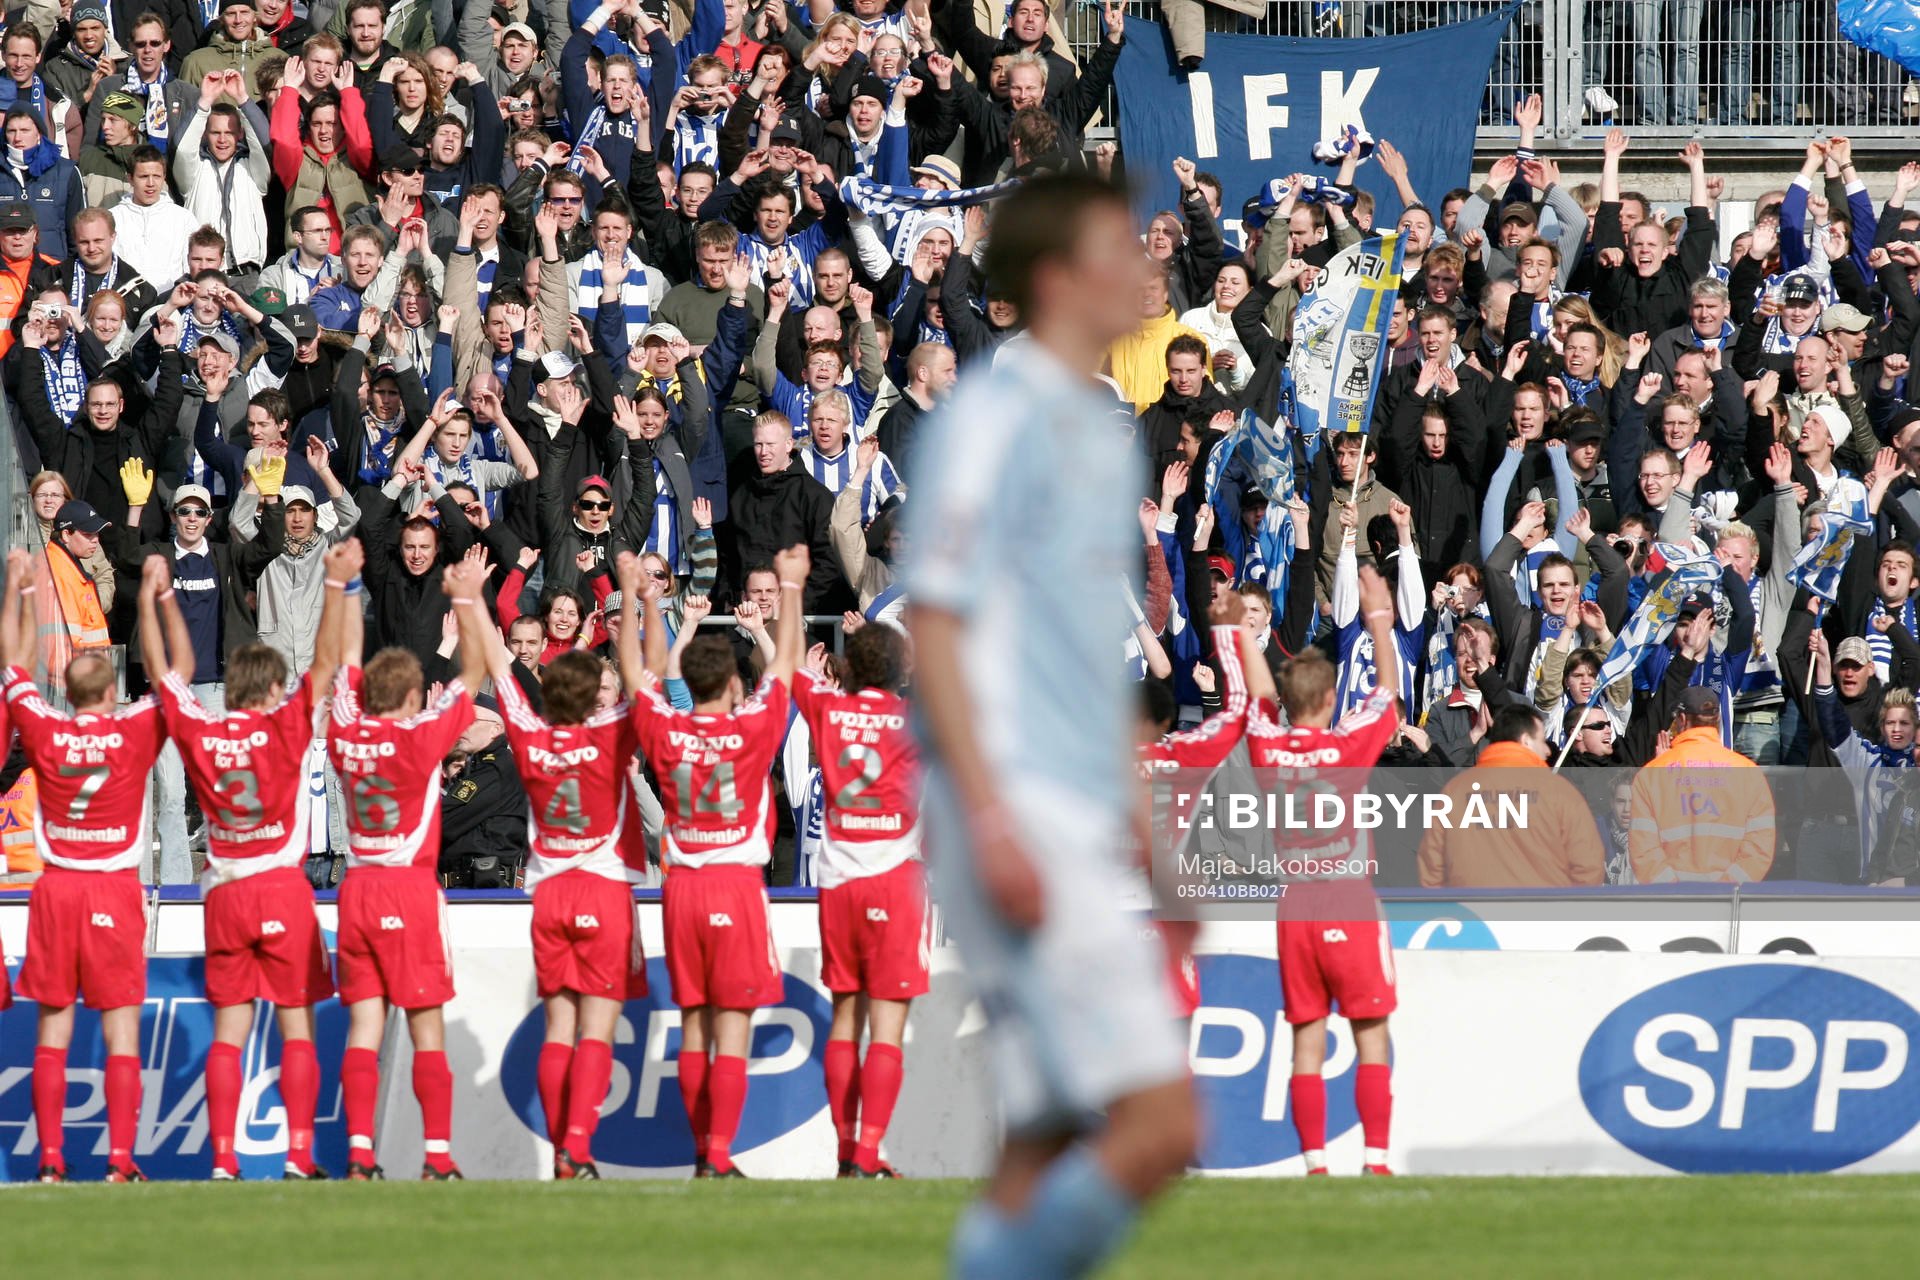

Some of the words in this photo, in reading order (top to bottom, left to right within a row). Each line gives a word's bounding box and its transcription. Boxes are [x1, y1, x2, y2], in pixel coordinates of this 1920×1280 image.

[1188, 67, 1380, 160] IFK
[293, 314, 305, 327] L
[829, 710, 904, 730] VOLVO
[53, 732, 123, 748] VOLVO
[668, 731, 743, 751] VOLVO
[840, 727, 858, 742] for
[66, 748, 82, 763] for
[1264, 748, 1341, 768] VOLVO
[836, 744, 882, 808] 2
[59, 766, 110, 819] 7
[215, 770, 262, 829] 3
[670, 762, 744, 823] 14
[543, 777, 591, 834] 4
[1681, 793, 1721, 815] ICA
[92, 913, 115, 928] ICA
[381, 916, 404, 929] ICA
[576, 915, 599, 928] ICA
[709, 913, 733, 926] ICA
[867, 908, 889, 921] ICA
[262, 920, 285, 934] ICA
[1323, 928, 1348, 942] ICA
[1623, 1012, 1909, 1133] SPP
